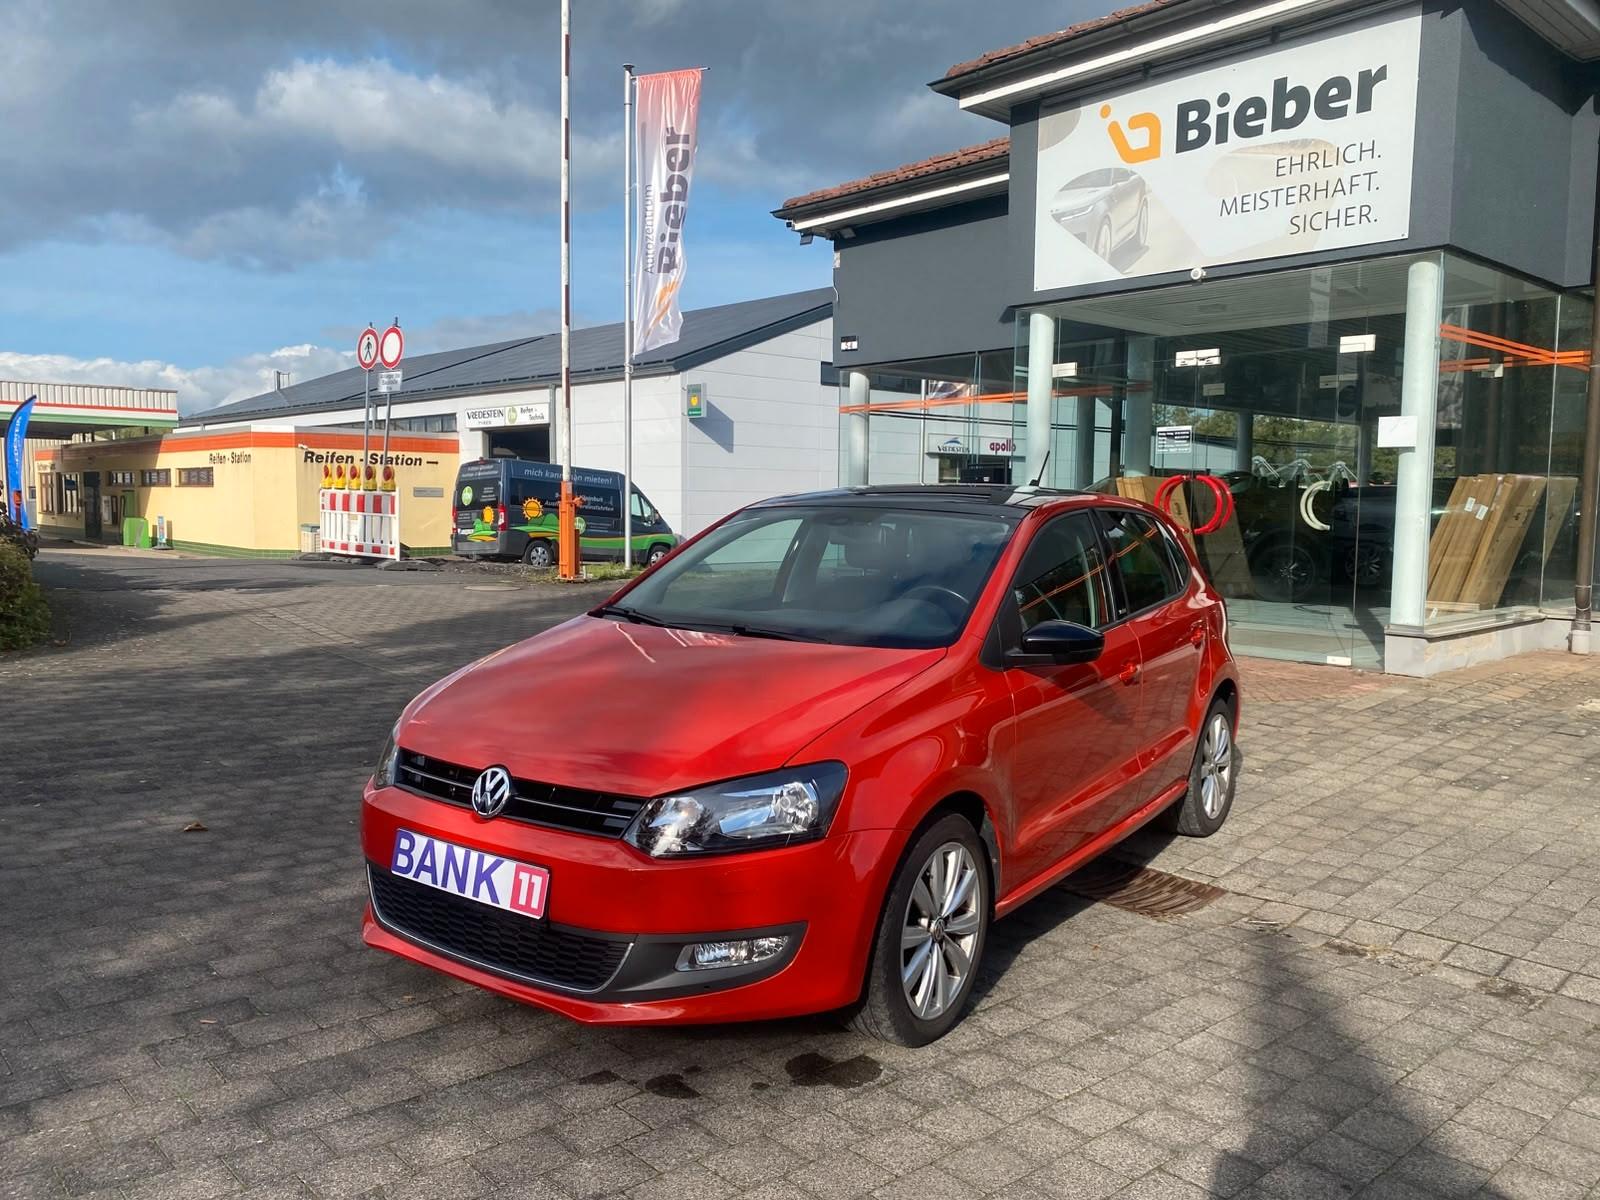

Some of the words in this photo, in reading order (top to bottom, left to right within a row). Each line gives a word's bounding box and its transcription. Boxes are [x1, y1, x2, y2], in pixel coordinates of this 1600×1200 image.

[1176, 64, 1387, 154] Bieber
[1276, 139, 1382, 178] EHRLICH.
[1220, 171, 1380, 217] MEISTERHAFT.
[1290, 204, 1378, 235] SICHER.
[466, 408, 504, 420] VREDESTEIN
[209, 452, 226, 465] Reifen
[231, 451, 252, 464] Station
[303, 451, 354, 465] Reifen
[368, 452, 423, 466] Station
[989, 438, 1016, 455] apollo
[524, 468, 543, 477] mich
[391, 829, 504, 904] BANK
[518, 870, 543, 909] 11
